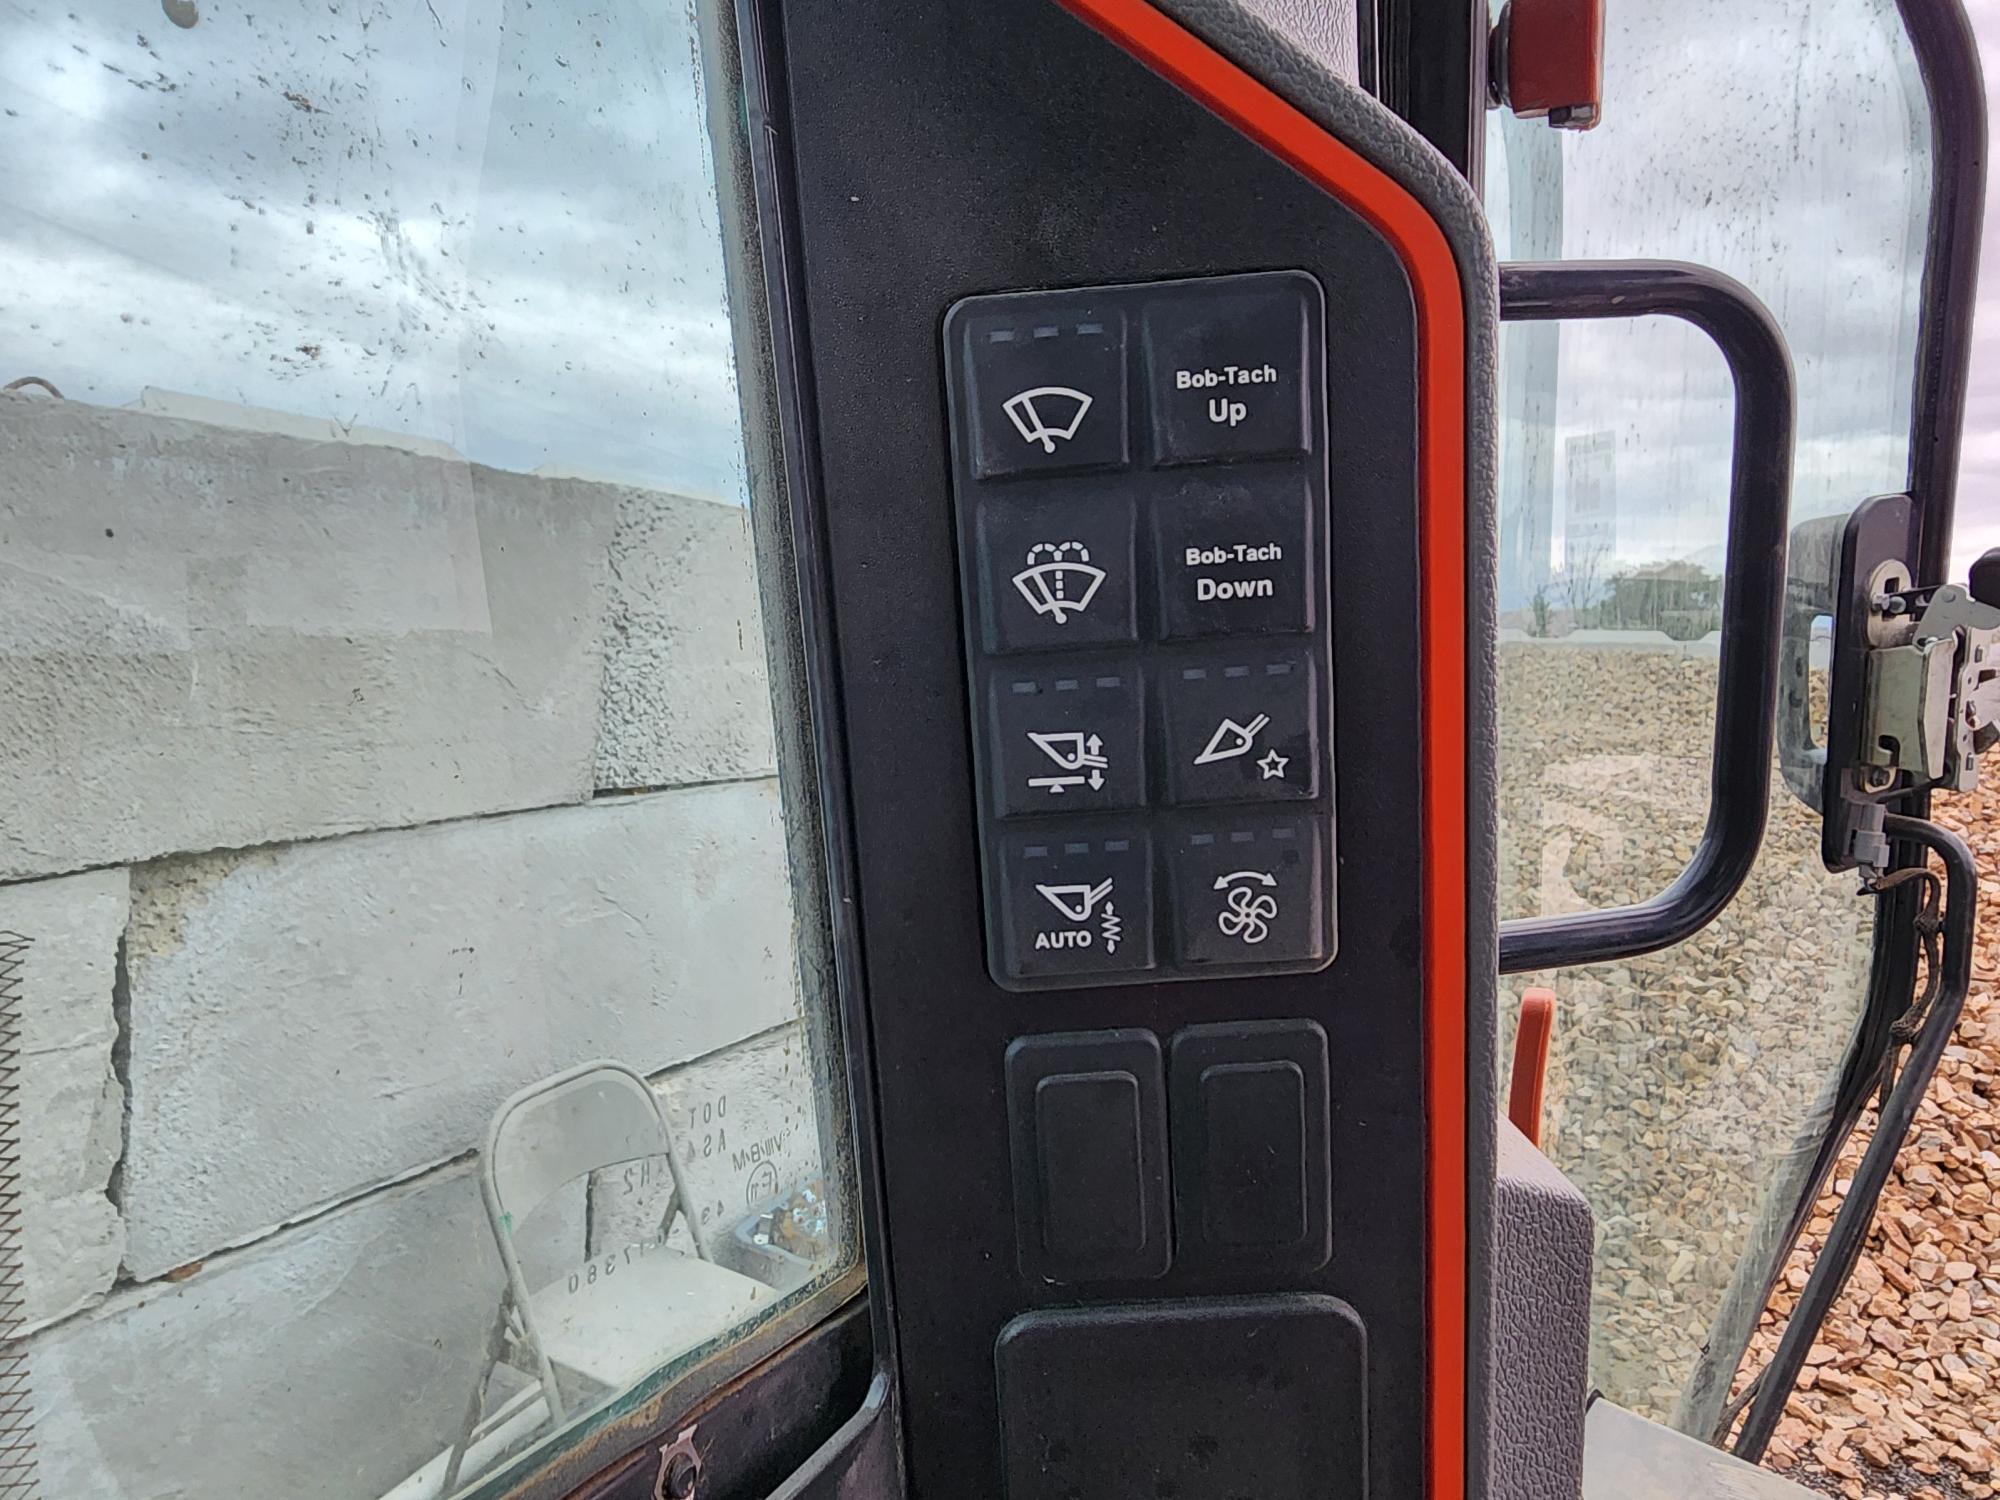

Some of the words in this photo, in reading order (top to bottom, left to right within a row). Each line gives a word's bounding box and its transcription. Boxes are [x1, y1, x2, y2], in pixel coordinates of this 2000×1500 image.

[1176, 364, 1277, 389] Bob-Tach
[1209, 398, 1247, 427] Up
[1185, 543, 1282, 565] Bob-Tach
[1197, 578, 1273, 600] Down
[1035, 930, 1092, 949] AUTO
